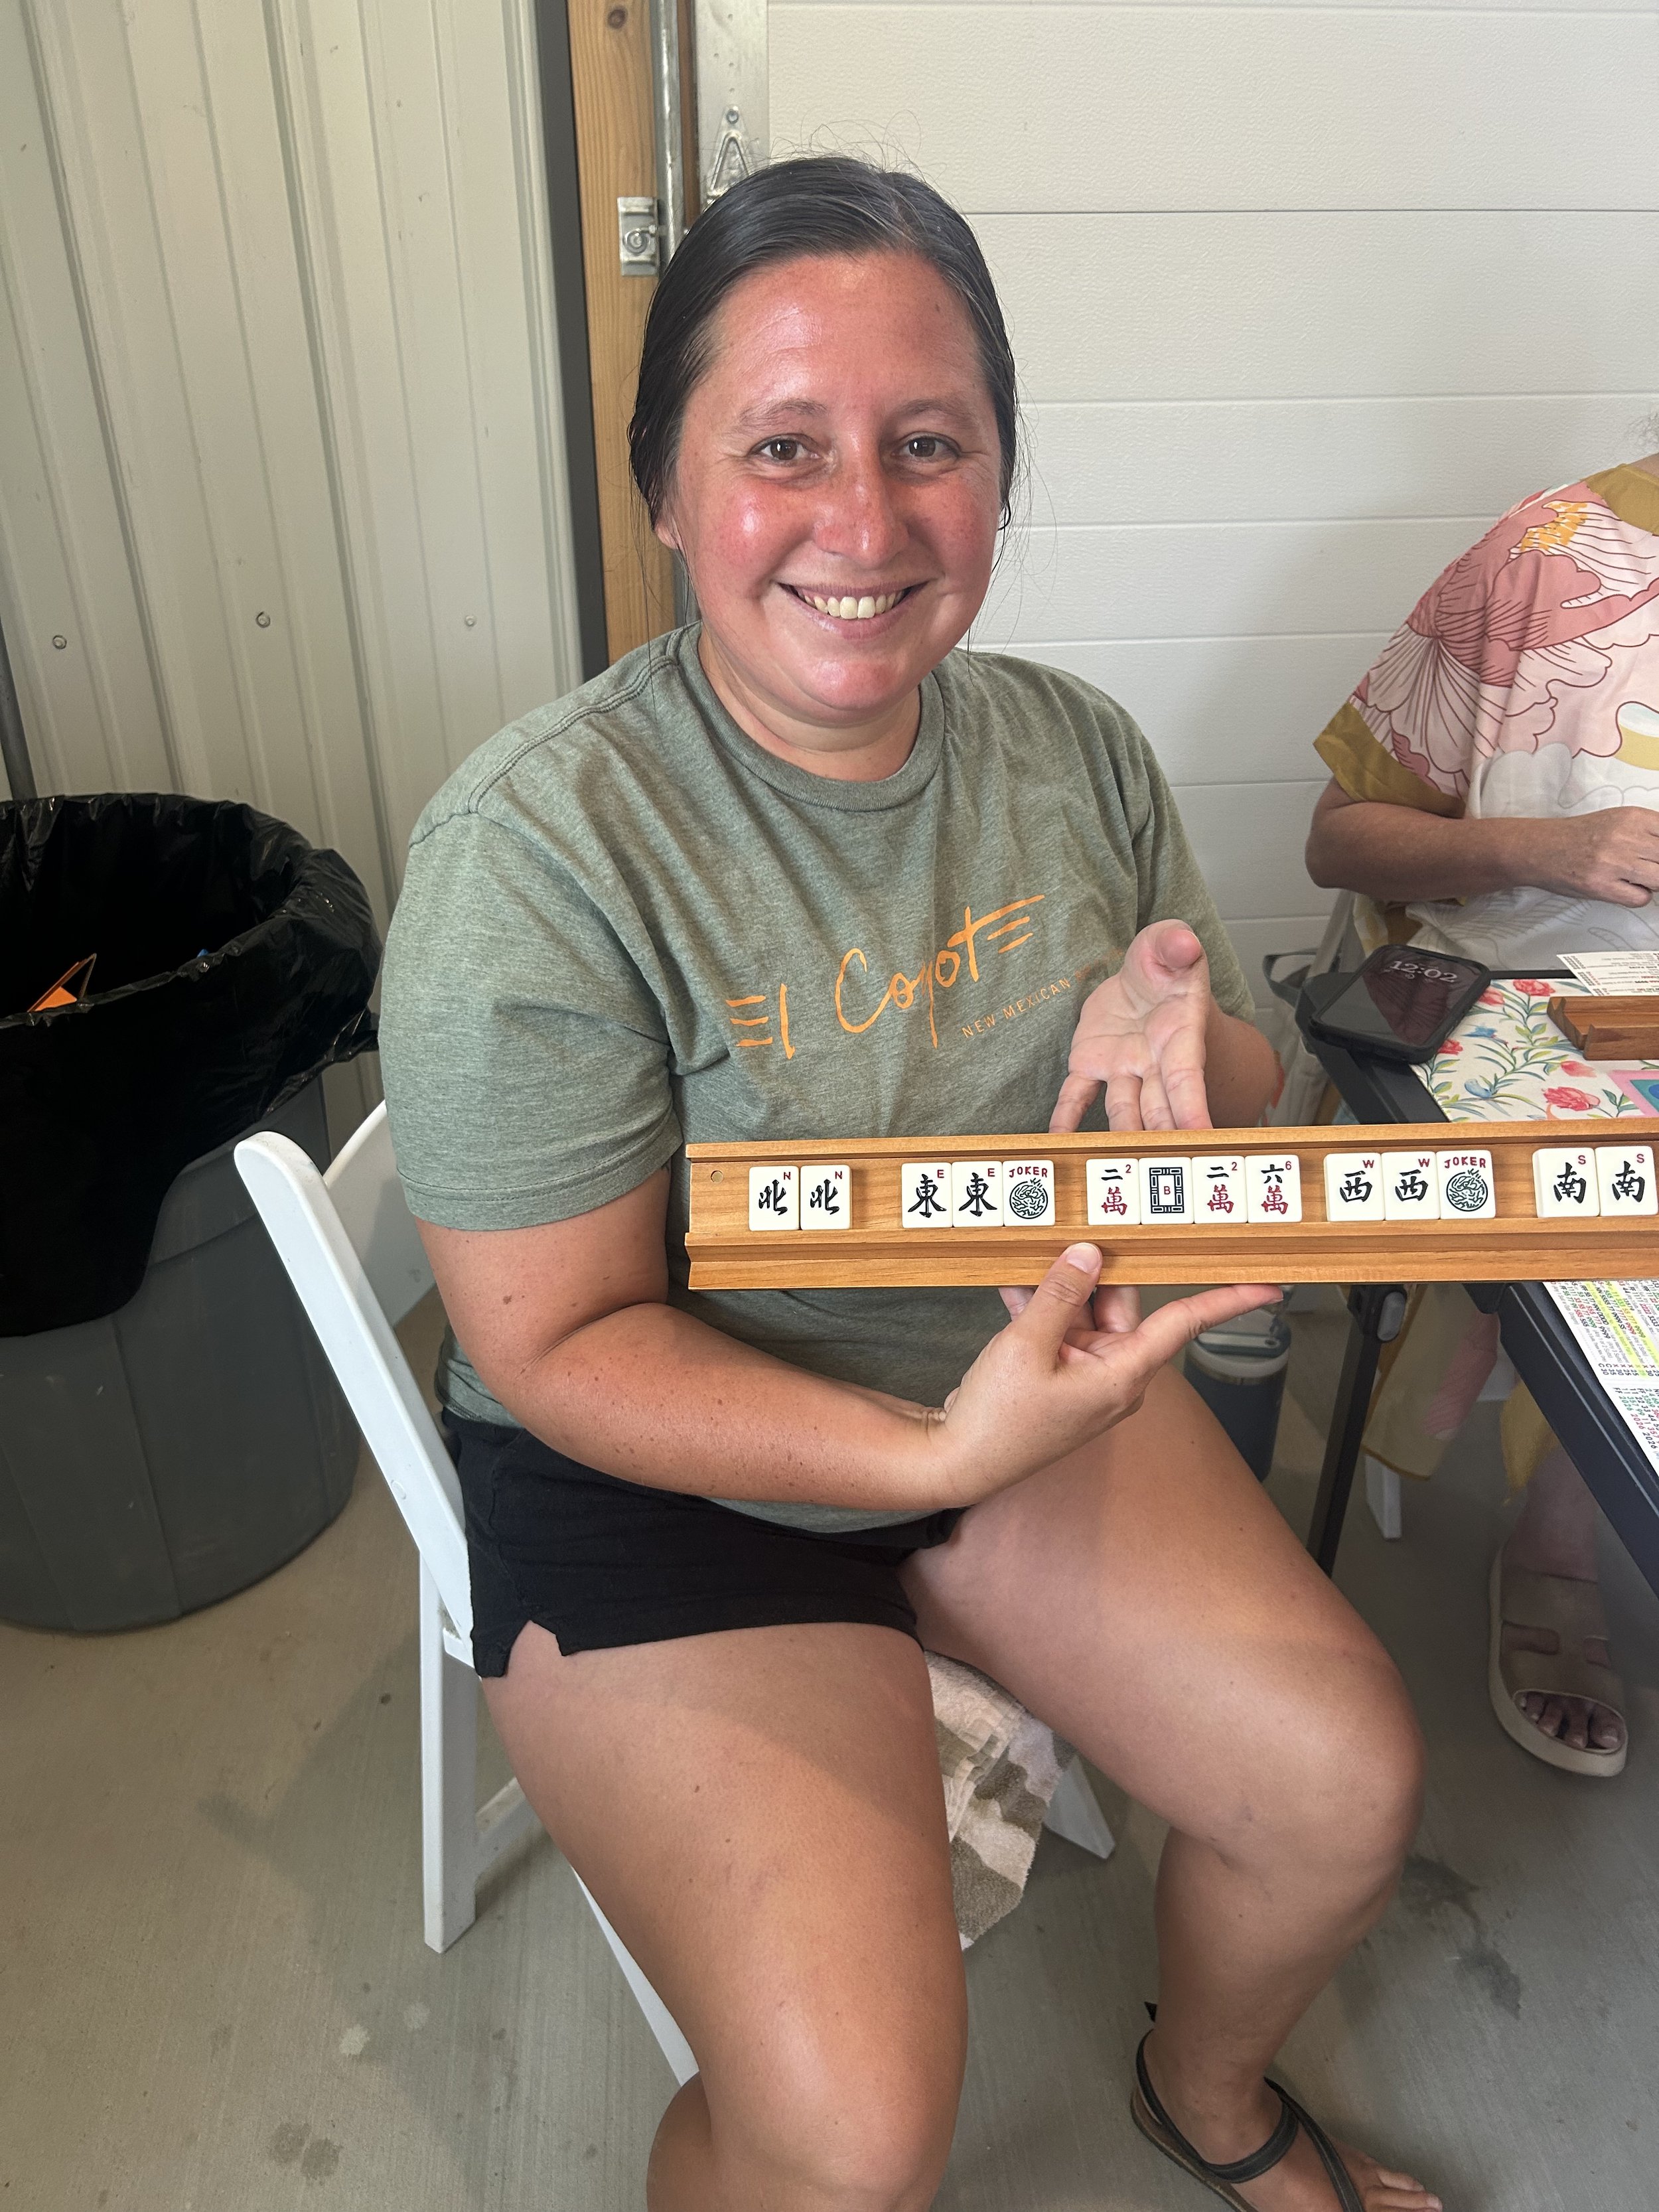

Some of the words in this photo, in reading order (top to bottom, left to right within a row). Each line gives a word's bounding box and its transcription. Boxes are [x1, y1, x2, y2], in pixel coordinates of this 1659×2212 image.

[834, 894, 1045, 1049] Coyote
[1390, 960, 1458, 983] 12:02
[961, 1013, 997, 1039] NEW
[1001, 977, 1072, 1020] MEXICAN
[1362, 1159, 1375, 1169] W
[1417, 1157, 1431, 1167] W
[1444, 1156, 1486, 1169] JOKER
[1577, 1155, 1586, 1165] S
[1636, 1153, 1645, 1163] S
[1125, 1163, 1132, 1173] 2
[1231, 1161, 1238, 1171] 2
[1285, 1160, 1292, 1171] 6
[783, 1171, 792, 1181] N
[835, 1170, 843, 1180] N
[936, 1169, 946, 1179] E
[987, 1167, 996, 1177] E
[1009, 1166, 1048, 1178] JOKER
[1339, 1169, 1373, 1203] 西
[1395, 1168, 1429, 1202] 西
[1553, 1161, 1587, 1204] 南
[1612, 1159, 1646, 1203] 南
[908, 1173, 947, 1218] 東
[958, 1172, 999, 1217] 東
[1163, 1185, 1171, 1195] B
[758, 1179, 788, 1216] 北
[810, 1178, 839, 1216] 北
